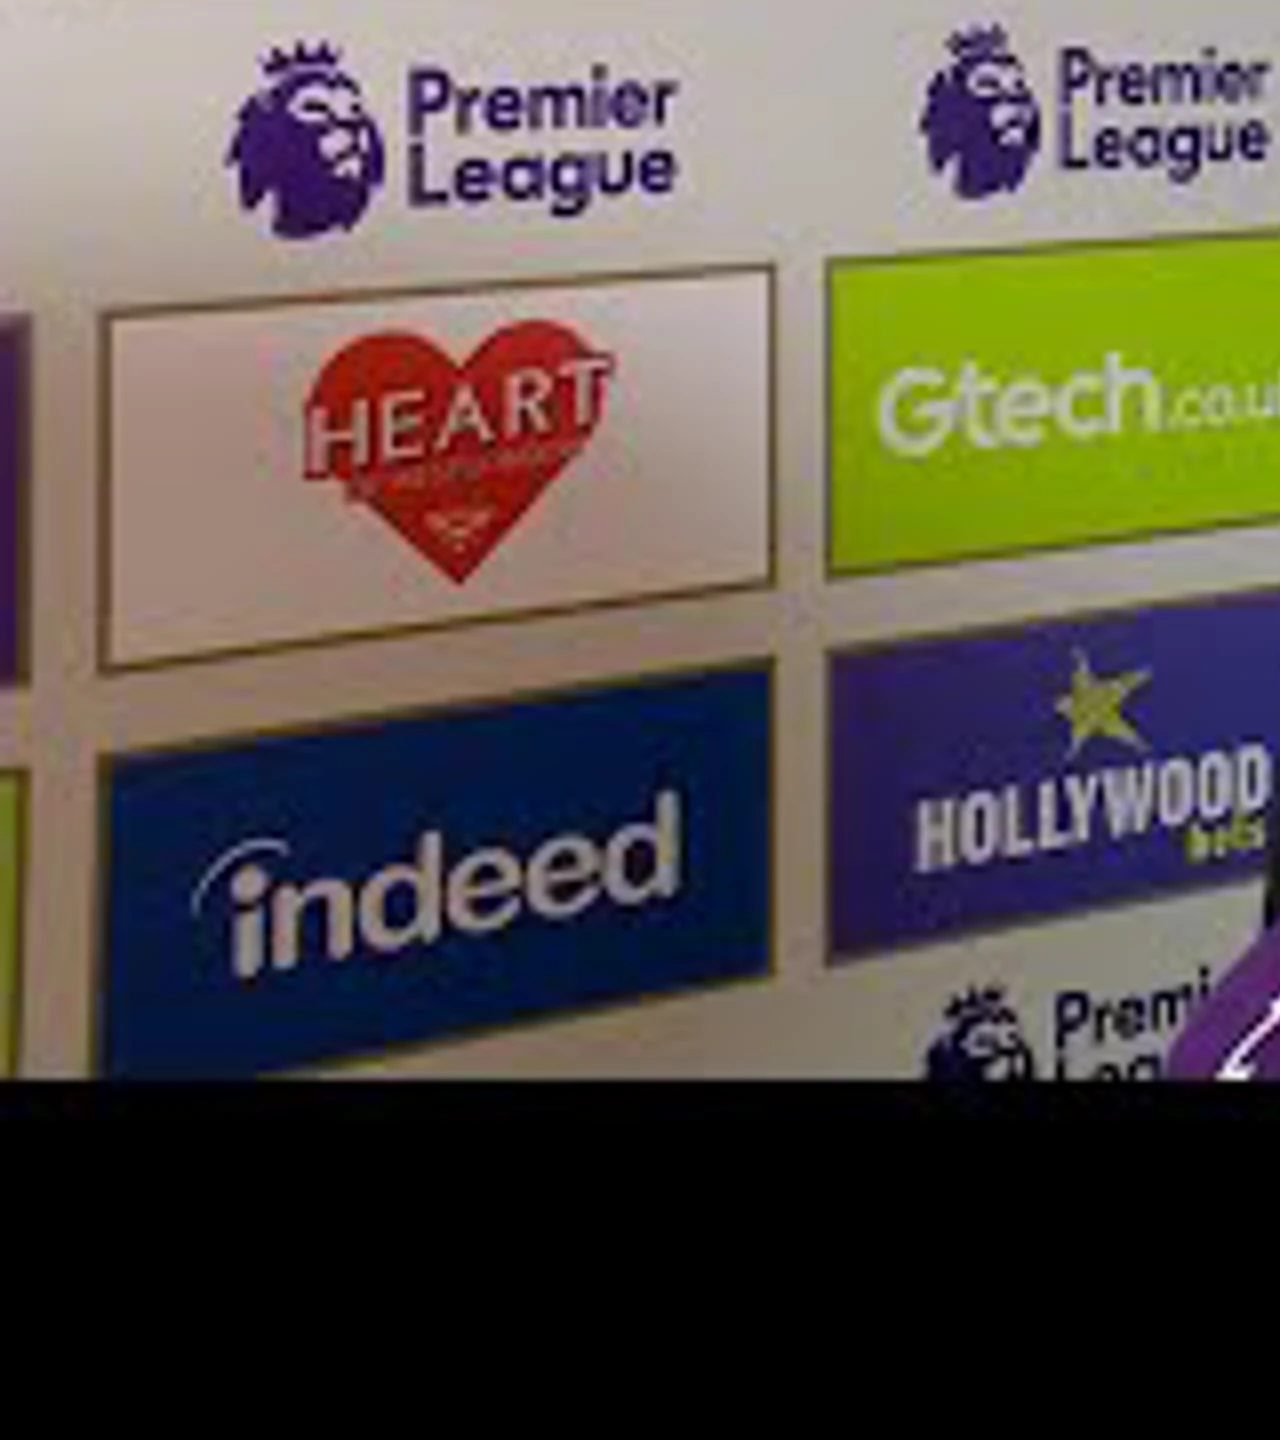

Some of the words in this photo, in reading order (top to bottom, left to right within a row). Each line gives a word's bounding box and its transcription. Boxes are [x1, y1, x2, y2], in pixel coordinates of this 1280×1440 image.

[408, 64, 678, 136] Premier
[1058, 46, 1272, 108] Premier
[408, 144, 678, 216] League
[1058, 108, 1272, 184] League
[303, 352, 614, 482] HEART
[914, 744, 1271, 874] HOLLYWOOD
[230, 790, 684, 978] indeed
